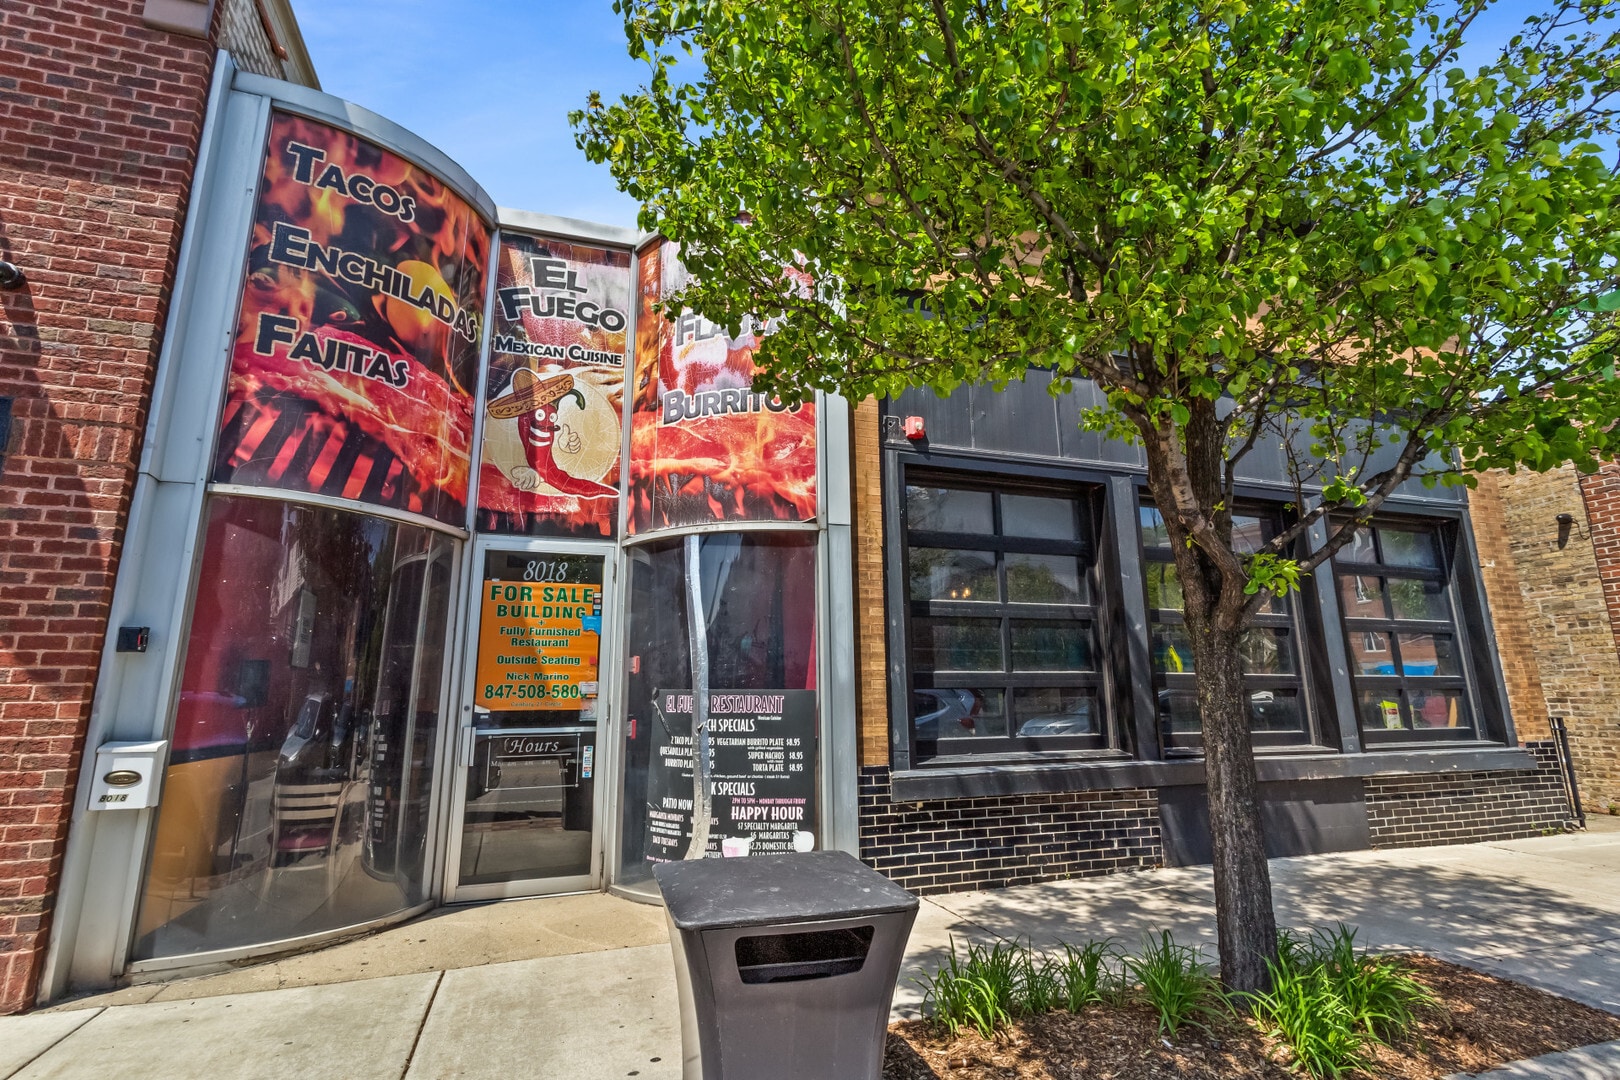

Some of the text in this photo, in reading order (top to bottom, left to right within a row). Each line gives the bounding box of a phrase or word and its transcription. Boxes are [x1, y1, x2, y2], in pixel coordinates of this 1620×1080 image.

[288, 141, 415, 222] TACOS
[268, 221, 477, 343] ENCHILADAS
[530, 257, 588, 294] EL
[498, 286, 627, 333] FUEGO
[254, 312, 408, 388] FAJITAS
[494, 335, 624, 368] MEXICAN CUISINE
[523, 561, 568, 582] 8018
[491, 585, 594, 604] FOR SALE
[497, 605, 586, 619] BUILDING
[500, 627, 580, 637] Fully Furnished
[511, 638, 569, 648] Restaurant
[497, 656, 580, 666] Outside Seating
[506, 672, 569, 681] Nick Marino
[665, 694, 676, 713] EL
[711, 695, 784, 713] RESTAURANT
[718, 718, 755, 732] SPECIALS
[504, 737, 559, 753] Hours
[747, 737, 768, 746] BURRITO
[769, 737, 784, 746] PLATE
[786, 737, 800, 746] $8.95
[747, 752, 803, 760] SUPER NACHOS $8.95
[752, 763, 803, 772] TORTA PLATE $8.95
[718, 782, 756, 796] SPECIALS
[99, 794, 128, 802] 8018
[662, 797, 693, 810] PATIO NOW
[731, 806, 803, 820] HAPPY HOUR
[737, 822, 743, 830] $7
[744, 822, 769, 830] SPECIALTY
[758, 832, 790, 840] MARGARITAS
[762, 842, 786, 850] DOMESTIC
